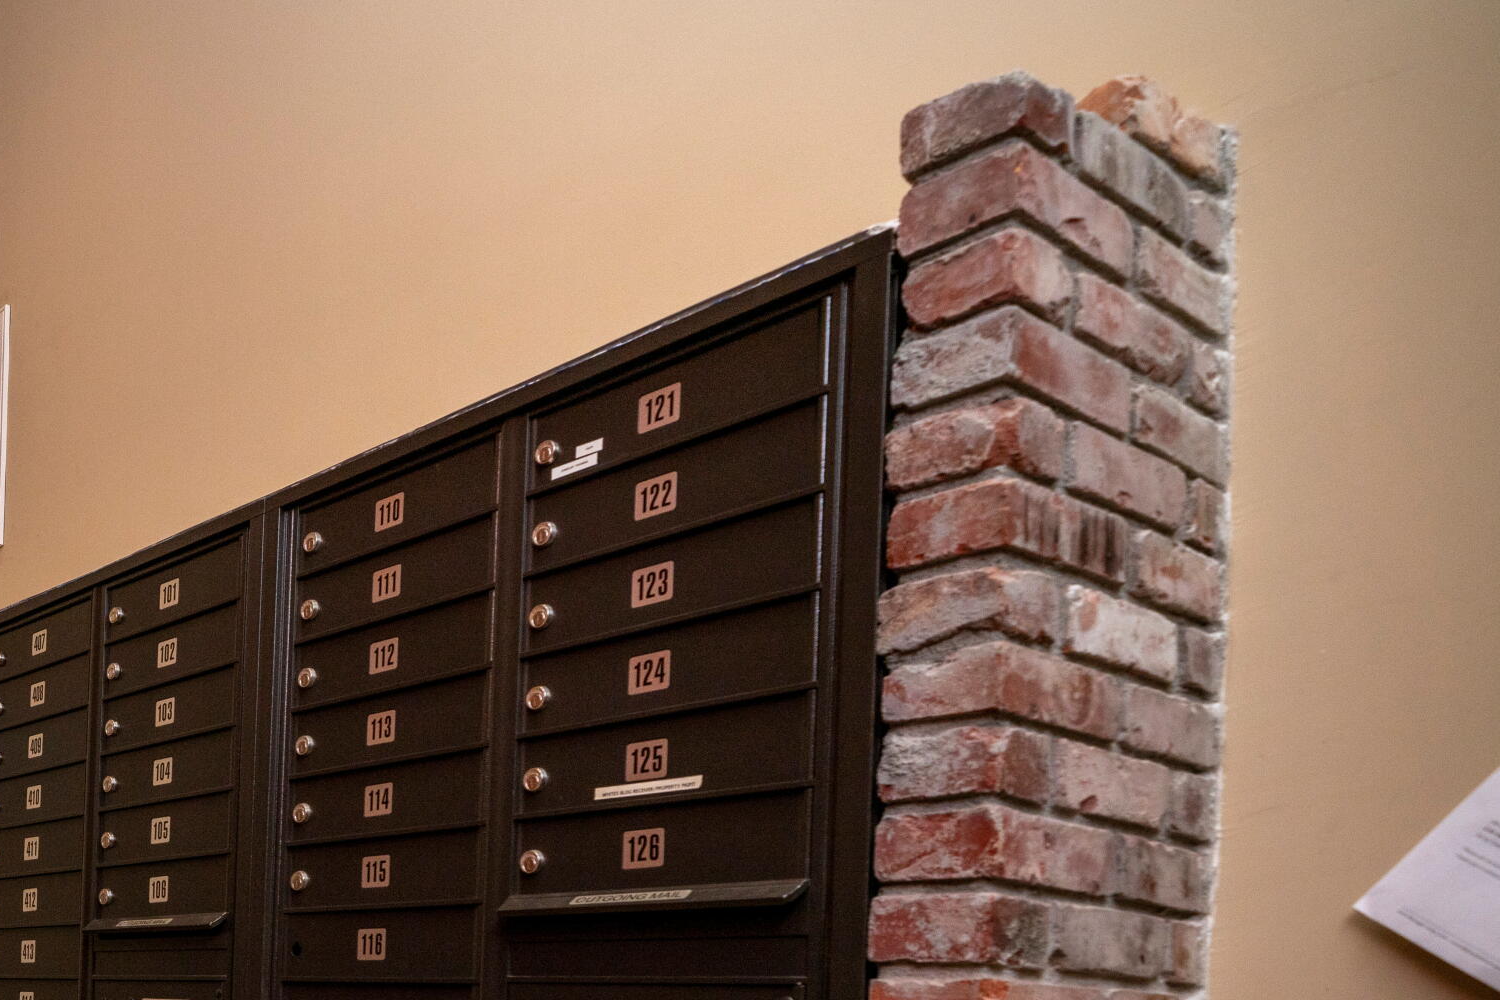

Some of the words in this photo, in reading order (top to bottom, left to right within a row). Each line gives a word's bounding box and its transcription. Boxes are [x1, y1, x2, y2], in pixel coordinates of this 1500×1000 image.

[645, 390, 675, 425] 121
[640, 479, 672, 514] 122
[379, 498, 400, 526] 110
[163, 582, 177, 605] 101
[377, 570, 396, 597] 111
[637, 568, 668, 601] 123
[34, 633, 46, 652] 407
[160, 642, 175, 663] 102
[374, 643, 395, 669] 112
[634, 657, 666, 688] 124
[158, 701, 173, 722] 103
[371, 715, 392, 740] 113
[30, 737, 42, 755] 409
[156, 761, 170, 782] 104
[631, 745, 663, 775] 125
[28, 788, 40, 806] 410
[368, 788, 389, 812] 114
[154, 820, 169, 840] 105
[26, 840, 37, 857] 411
[628, 834, 660, 863] 126
[366, 860, 387, 883] 115
[24, 891, 36, 908] 412
[152, 880, 166, 899] 106
[574, 894, 647, 904] OUTGOING
[649, 891, 682, 899] MAIL
[22, 943, 34, 960] 413
[362, 933, 383, 956] 116
